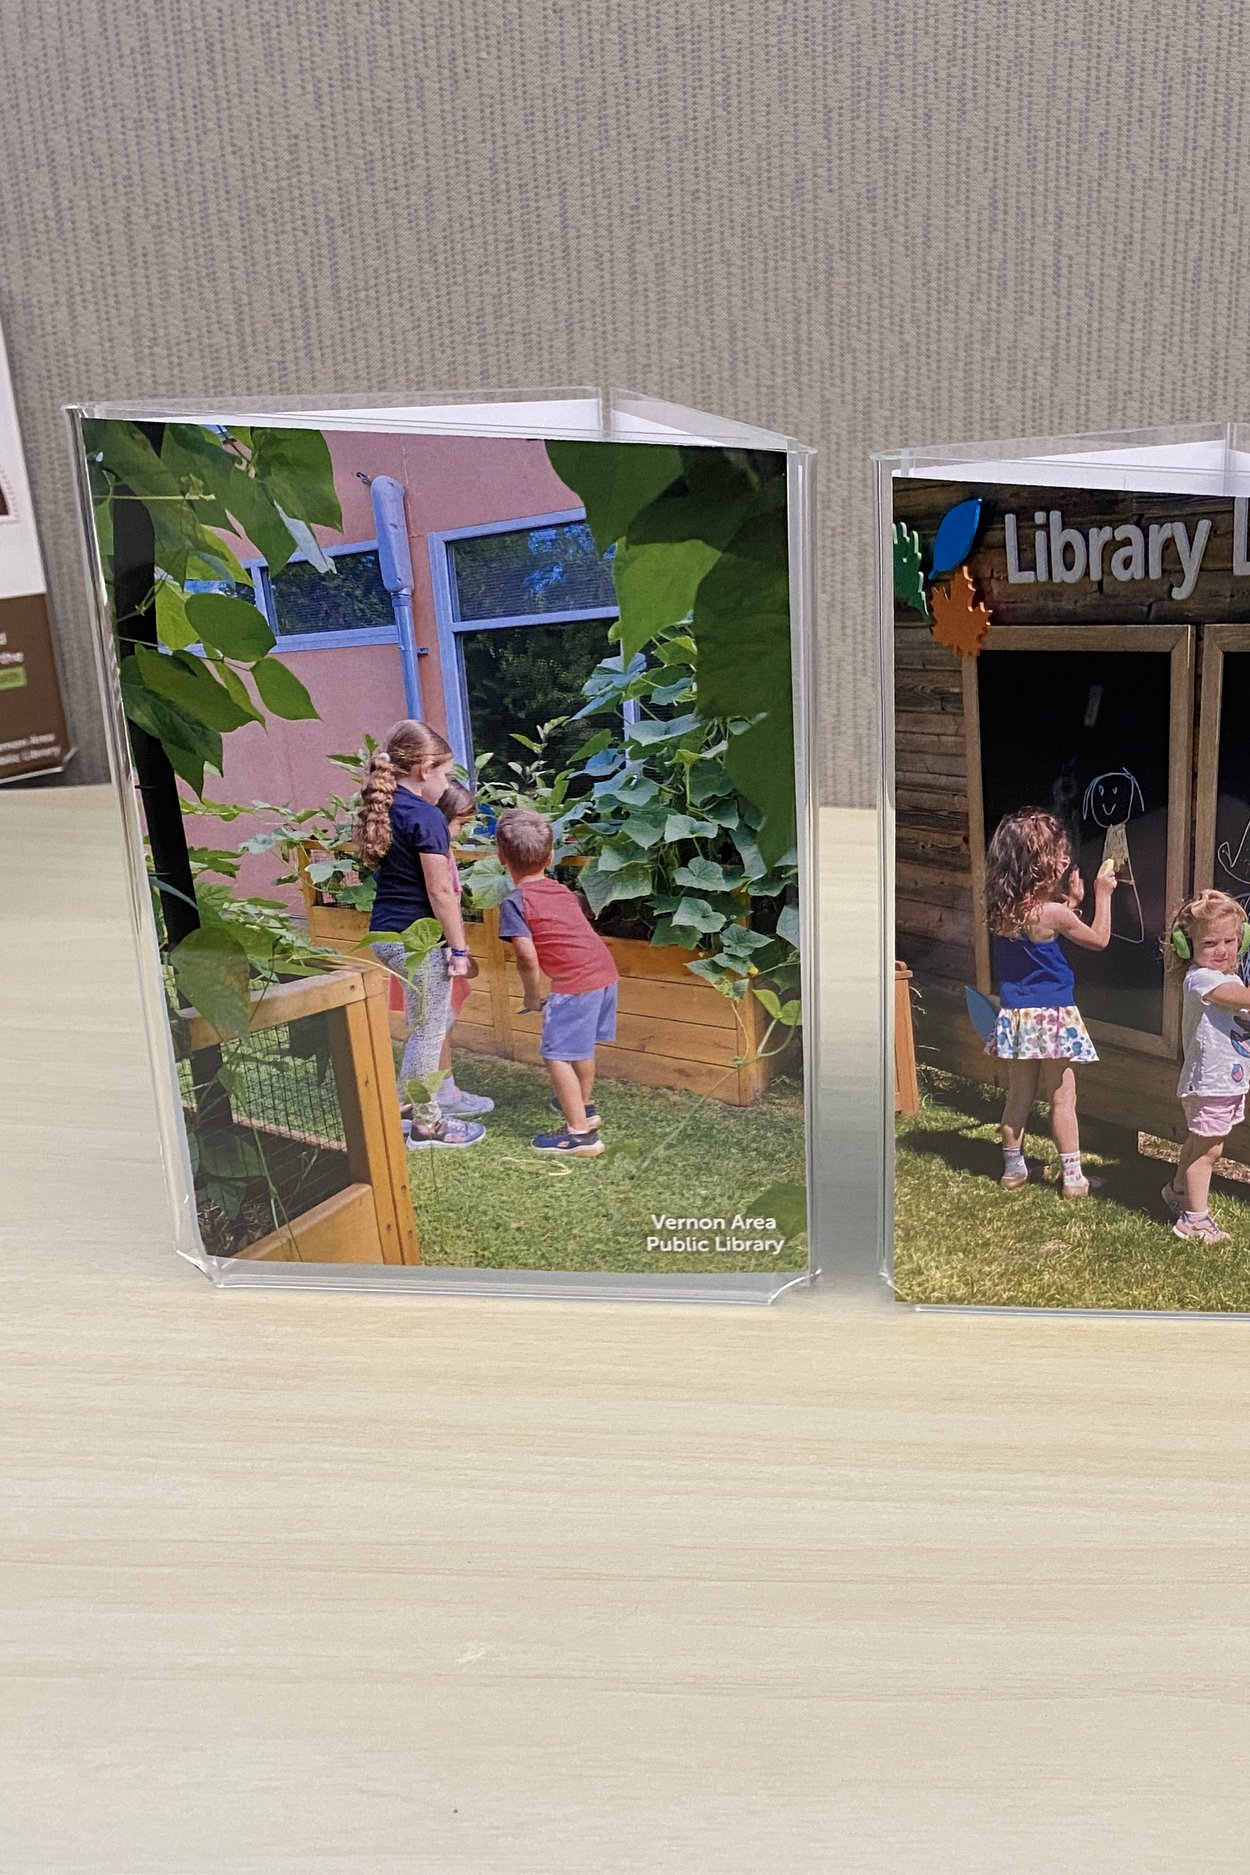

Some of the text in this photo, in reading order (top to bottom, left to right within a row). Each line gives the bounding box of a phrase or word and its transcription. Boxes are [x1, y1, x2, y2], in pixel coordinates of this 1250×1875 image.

[1004, 510, 1211, 600] Library
[651, 1214, 777, 1230] Vernon Area
[646, 1236, 785, 1255] Public Library
